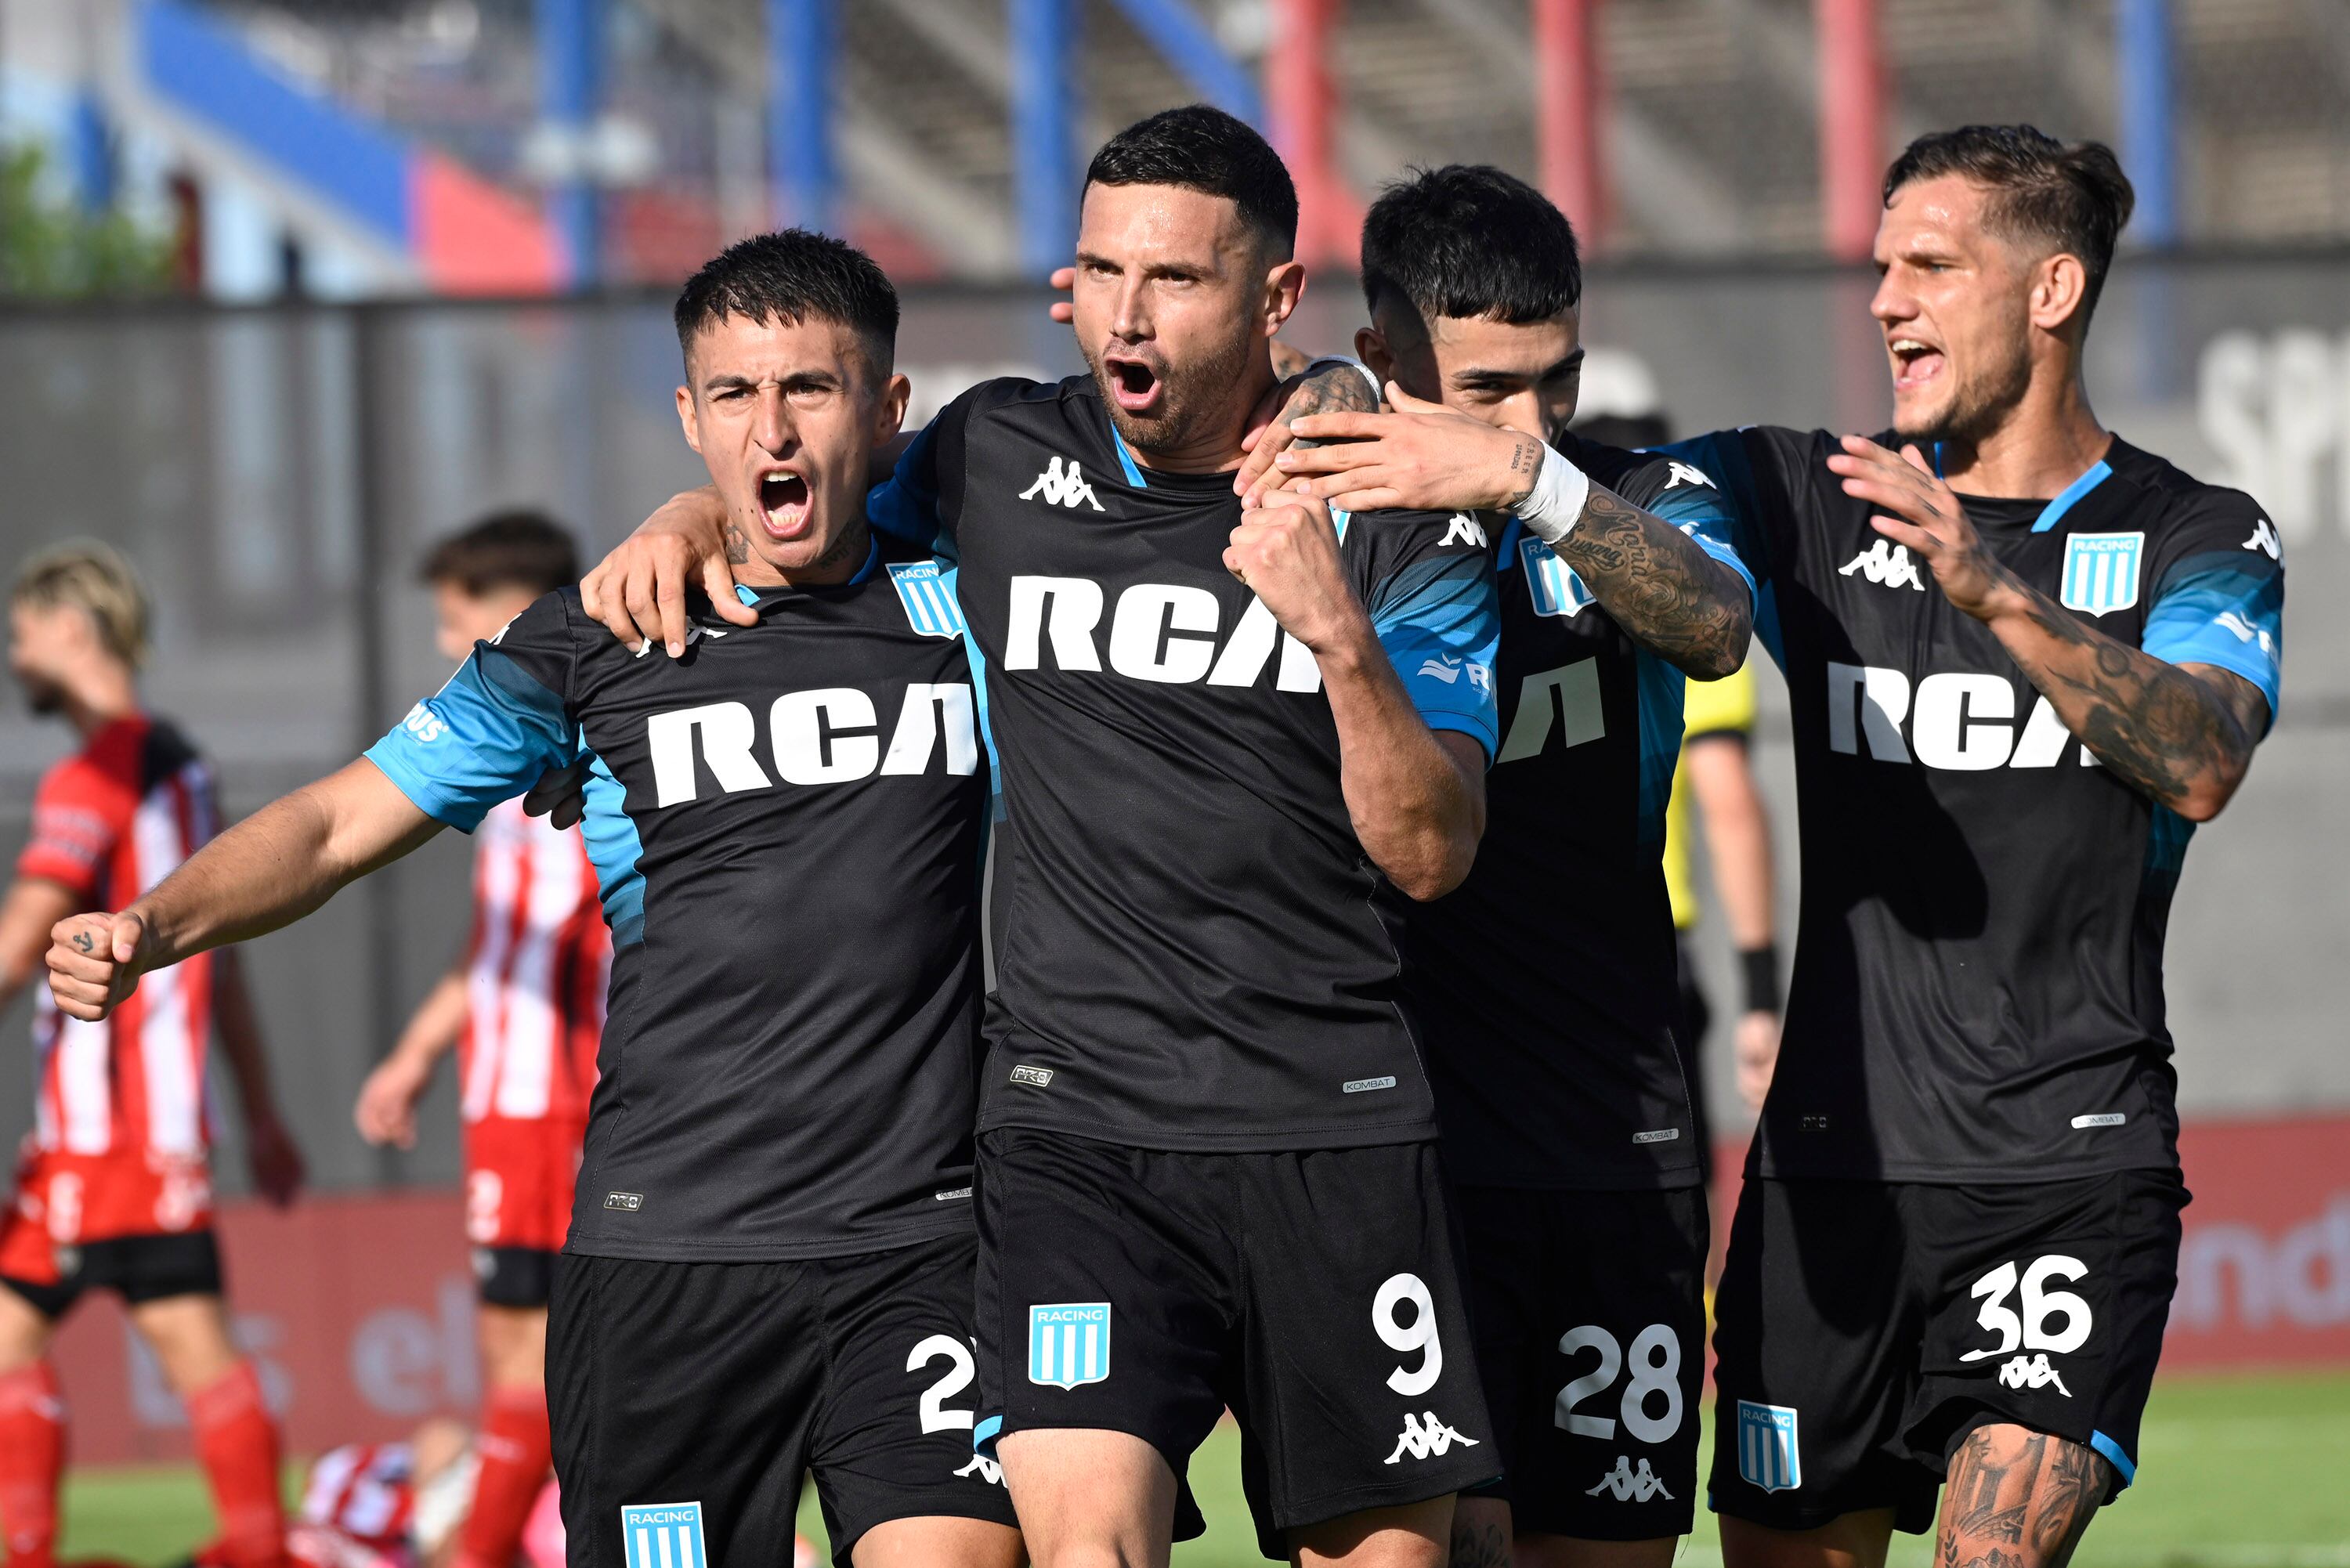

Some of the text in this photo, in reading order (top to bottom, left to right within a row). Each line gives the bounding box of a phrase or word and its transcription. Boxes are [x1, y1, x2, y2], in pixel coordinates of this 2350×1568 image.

[2073, 539, 2135, 551] RACING
[895, 566, 939, 580] RACIN
[648, 682, 978, 809] RCA
[1347, 1078, 1390, 1091] KOMBAT
[1636, 1130, 1674, 1142] KOMBAT
[940, 1189, 972, 1198] KOMB
[1958, 1254, 2093, 1363] 36
[1037, 1310, 1104, 1323] RACING
[1372, 1272, 1443, 1396] 9
[906, 1334, 978, 1436] 2
[1554, 1323, 1683, 1443] 28
[1742, 1409, 1791, 1428] RACING
[629, 1510, 695, 1525] RACING
